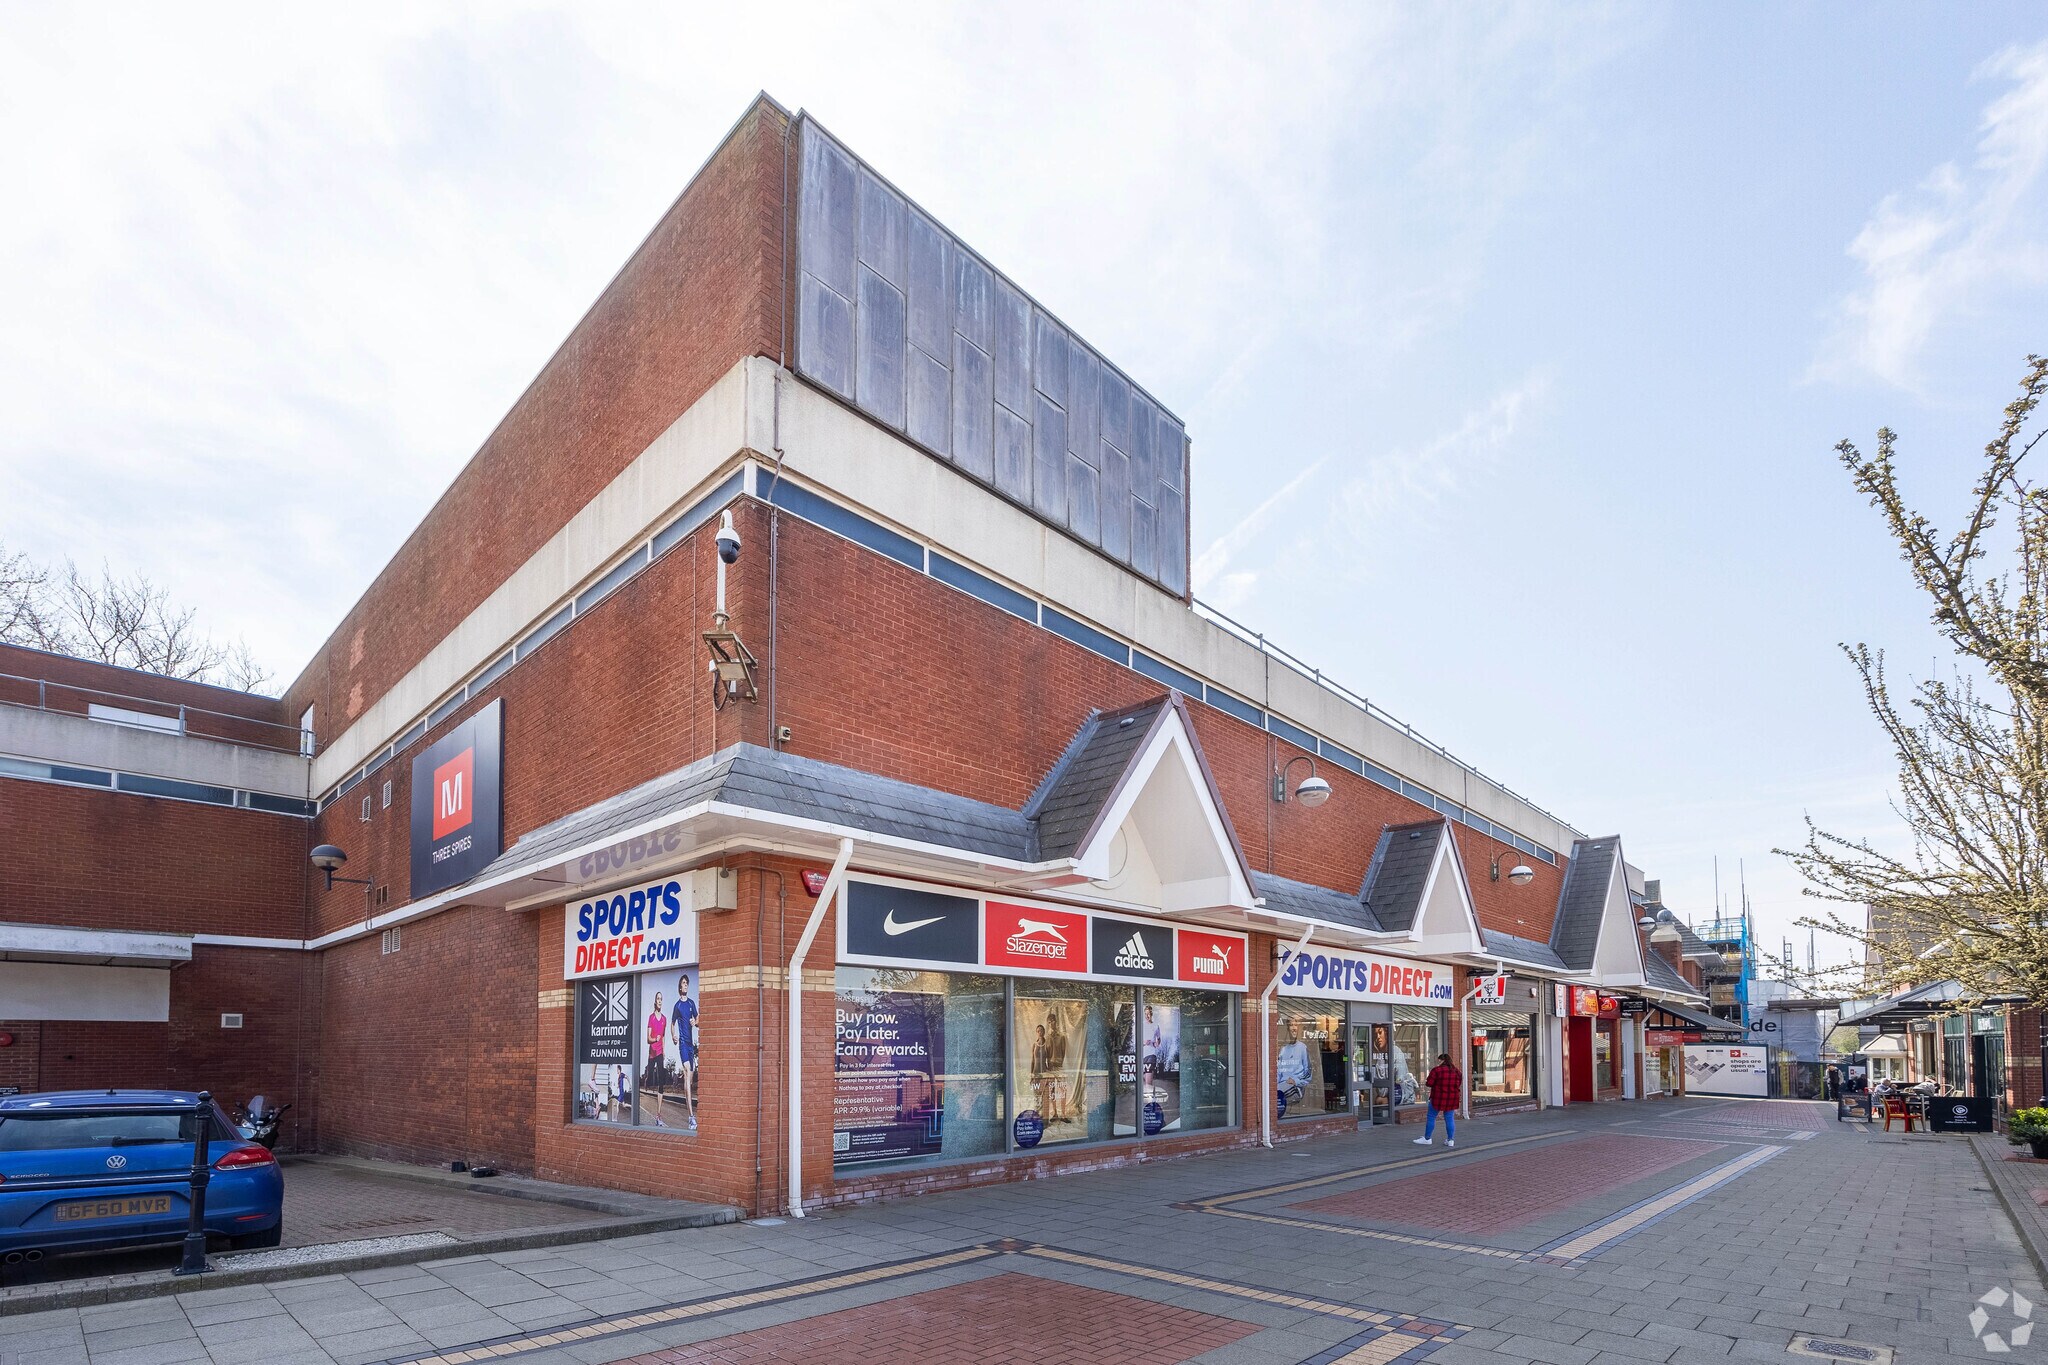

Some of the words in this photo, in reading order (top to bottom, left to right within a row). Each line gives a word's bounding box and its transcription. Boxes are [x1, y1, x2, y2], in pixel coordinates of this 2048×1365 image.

[441, 770, 463, 820] M
[432, 845, 451, 864] THREE
[451, 835, 472, 856] SPIRES
[577, 881, 681, 942] SPORTS
[574, 934, 681, 973] DIRECT.COM
[1006, 937, 1067, 959] Slazenger
[1114, 955, 1154, 970] adidas
[1193, 956, 1224, 975] PUMA
[1281, 951, 1367, 992] SPORTS
[835, 1008, 863, 1026] Buy
[866, 1013, 899, 1024] now.
[836, 1025, 863, 1042] Pay
[866, 1026, 900, 1040] later.
[590, 1049, 628, 1058] RUNNING
[836, 1042, 868, 1055] Earn
[871, 1042, 928, 1056] rewards.
[1118, 1055, 1136, 1064] FOR
[1123, 1064, 1151, 1073] EVY
[833, 1097, 884, 1105] Representative
[833, 1107, 848, 1115] APR
[849, 1106, 871, 1114] 29.9%
[872, 1104, 903, 1113] (variable)
[68, 1201, 123, 1219] GF60
[128, 1198, 167, 1214] MVR
